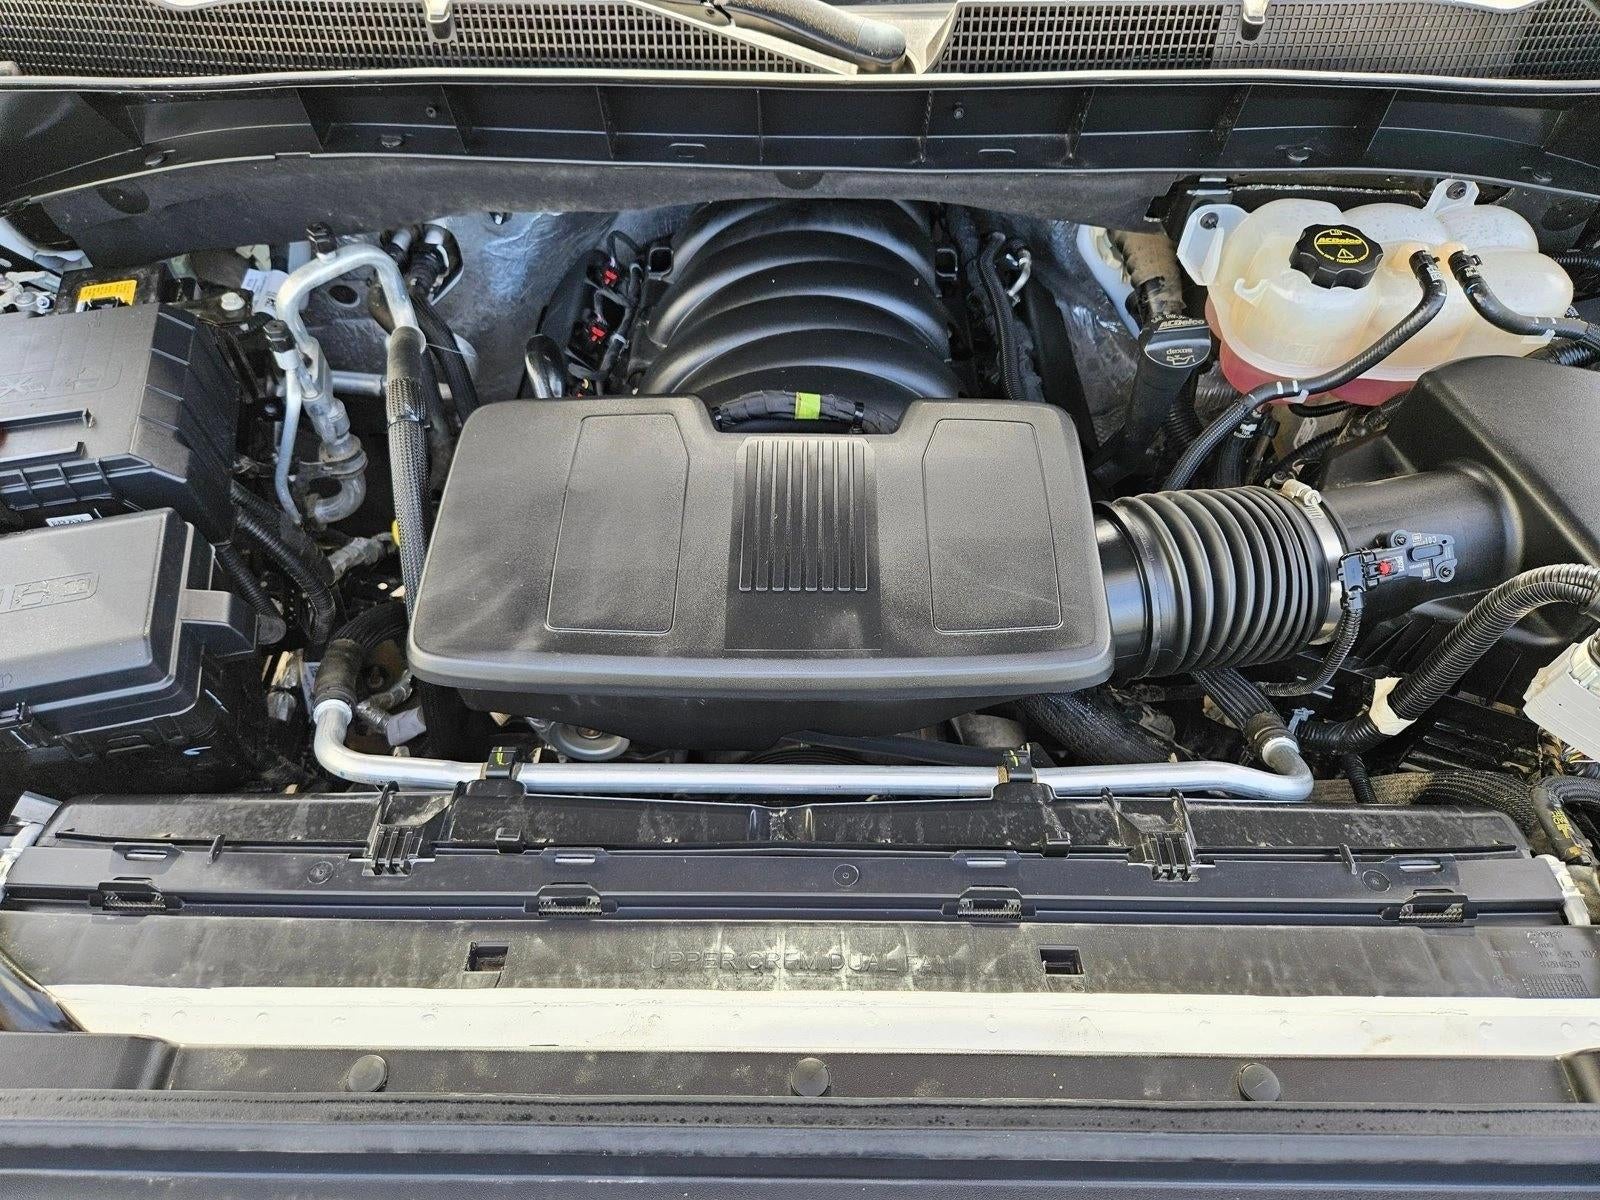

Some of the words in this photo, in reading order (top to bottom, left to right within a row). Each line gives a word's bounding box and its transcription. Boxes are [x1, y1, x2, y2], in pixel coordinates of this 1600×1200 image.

[1317, 236, 1363, 246] ACDelco
[1158, 318, 1205, 331] ACDelco
[650, 950, 737, 970] UPPER
[828, 952, 899, 972] DUAL
